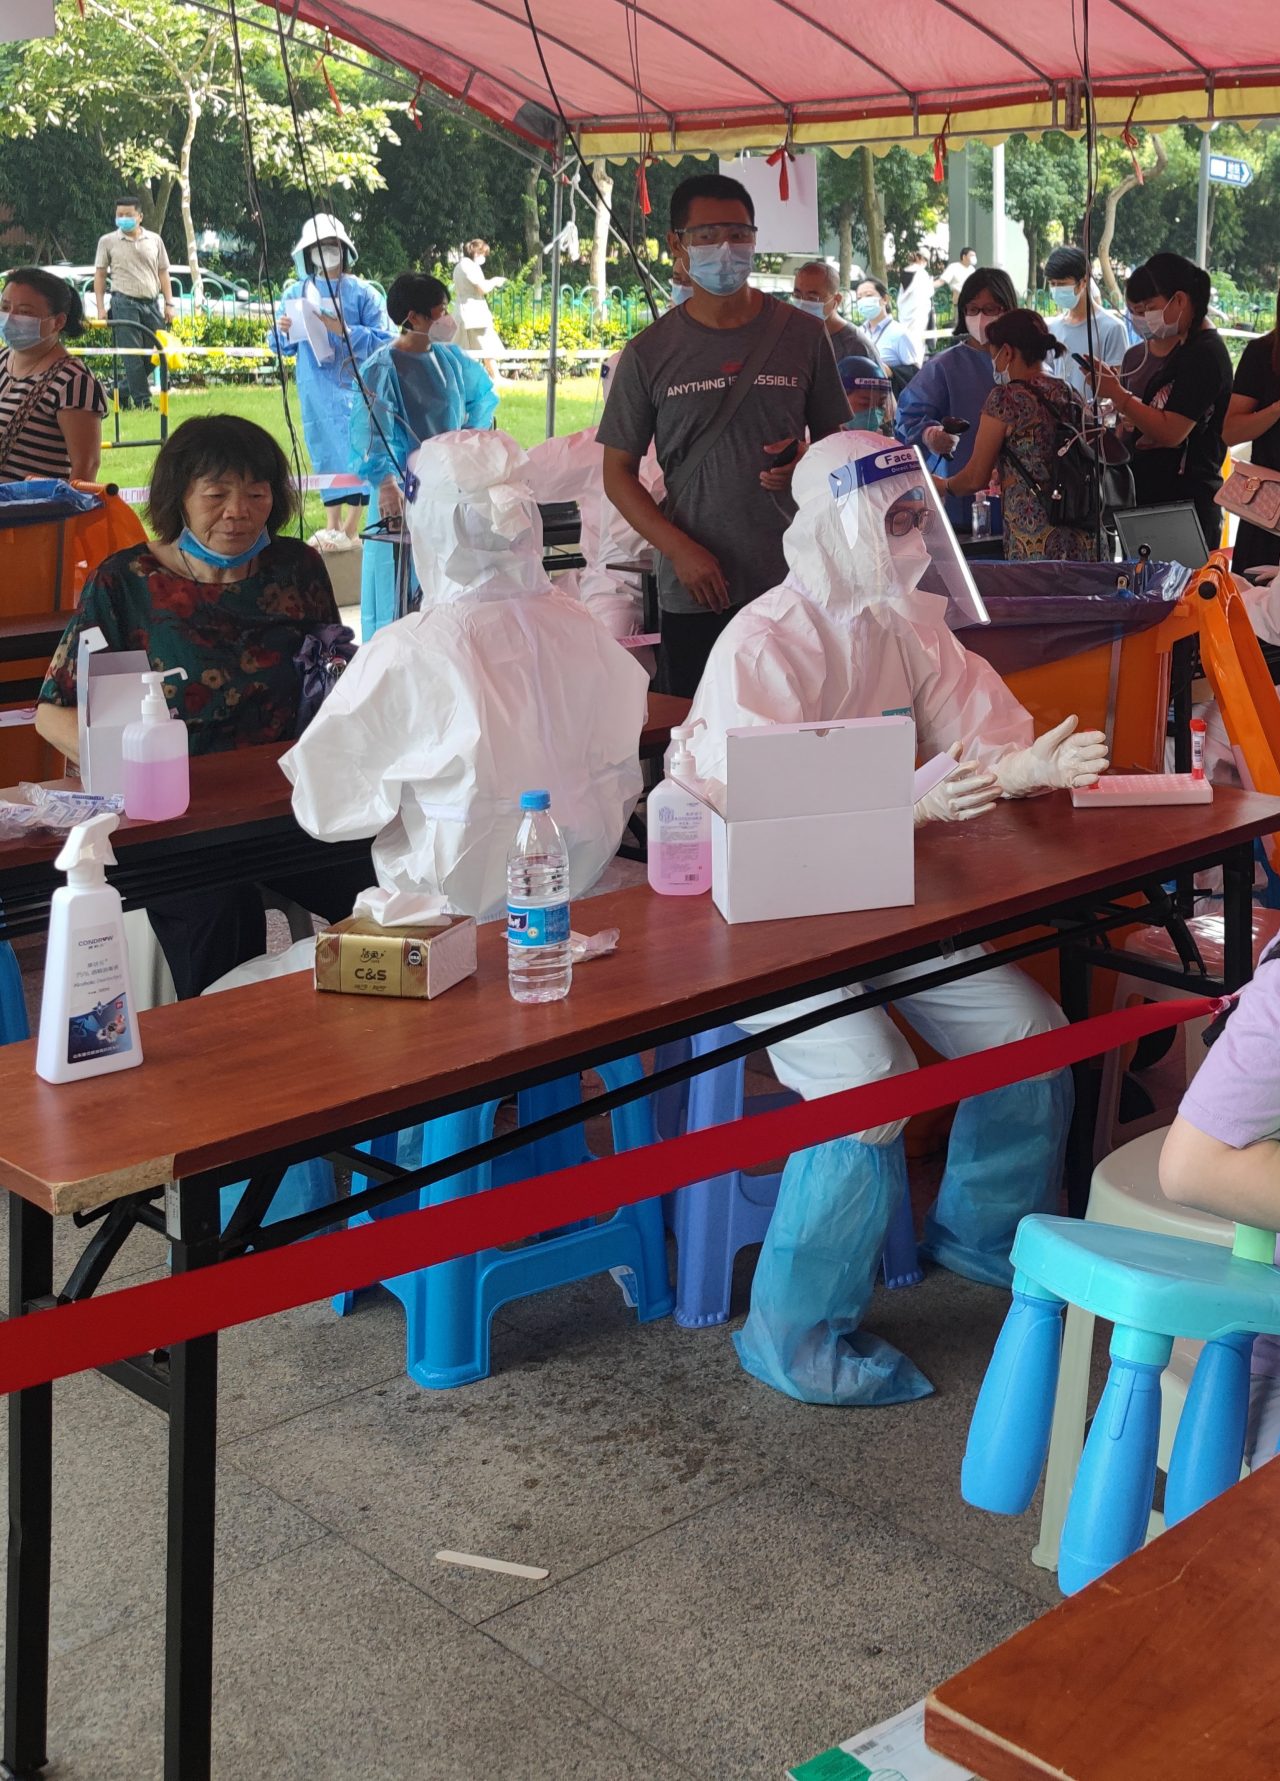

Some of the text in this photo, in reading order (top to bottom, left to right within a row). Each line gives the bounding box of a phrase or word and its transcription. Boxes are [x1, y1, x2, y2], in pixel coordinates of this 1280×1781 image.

[667, 377, 726, 397] ANYTHING
[753, 374, 799, 387] SSIBLE
[884, 453, 912, 465] Face
[354, 967, 387, 981] C&S
